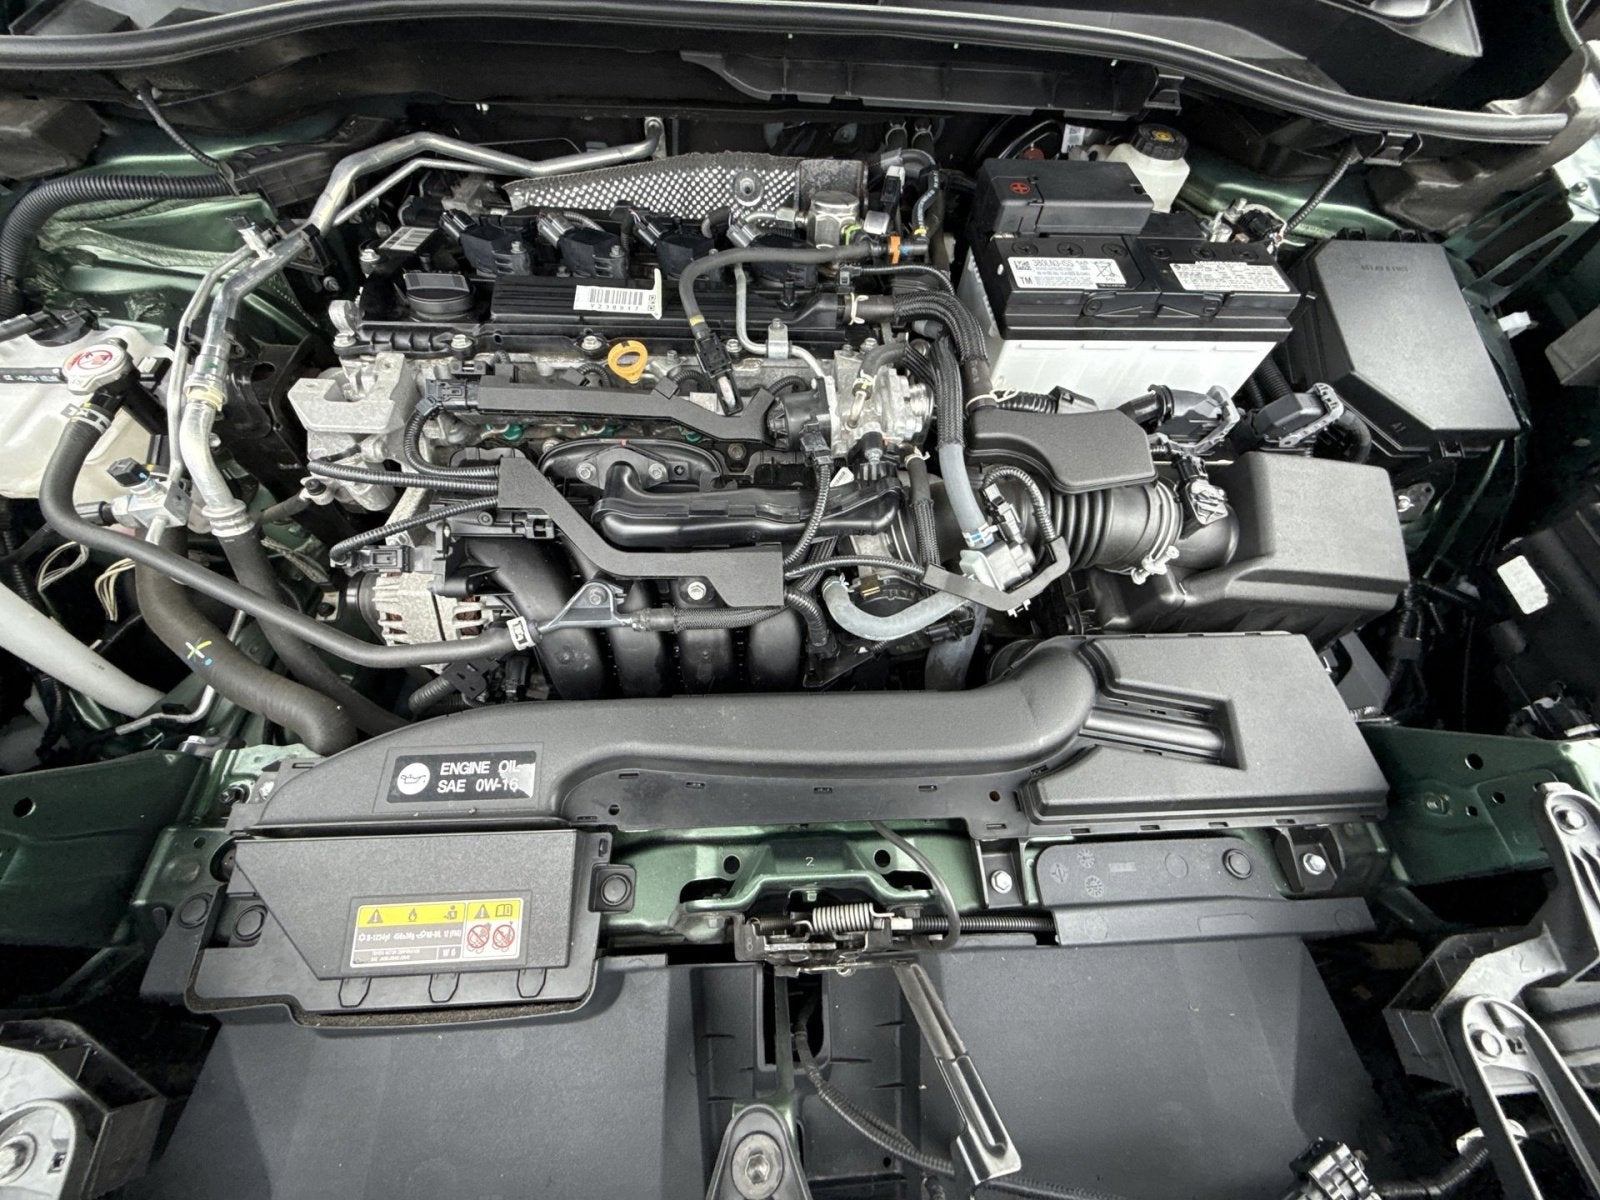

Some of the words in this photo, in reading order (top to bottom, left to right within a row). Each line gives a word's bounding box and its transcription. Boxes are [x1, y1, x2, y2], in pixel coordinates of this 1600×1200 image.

[440, 761, 490, 775] ENGINE
[499, 760, 520, 772] OIL
[437, 779, 466, 793] SAE
[476, 778, 519, 792] 0W-16
